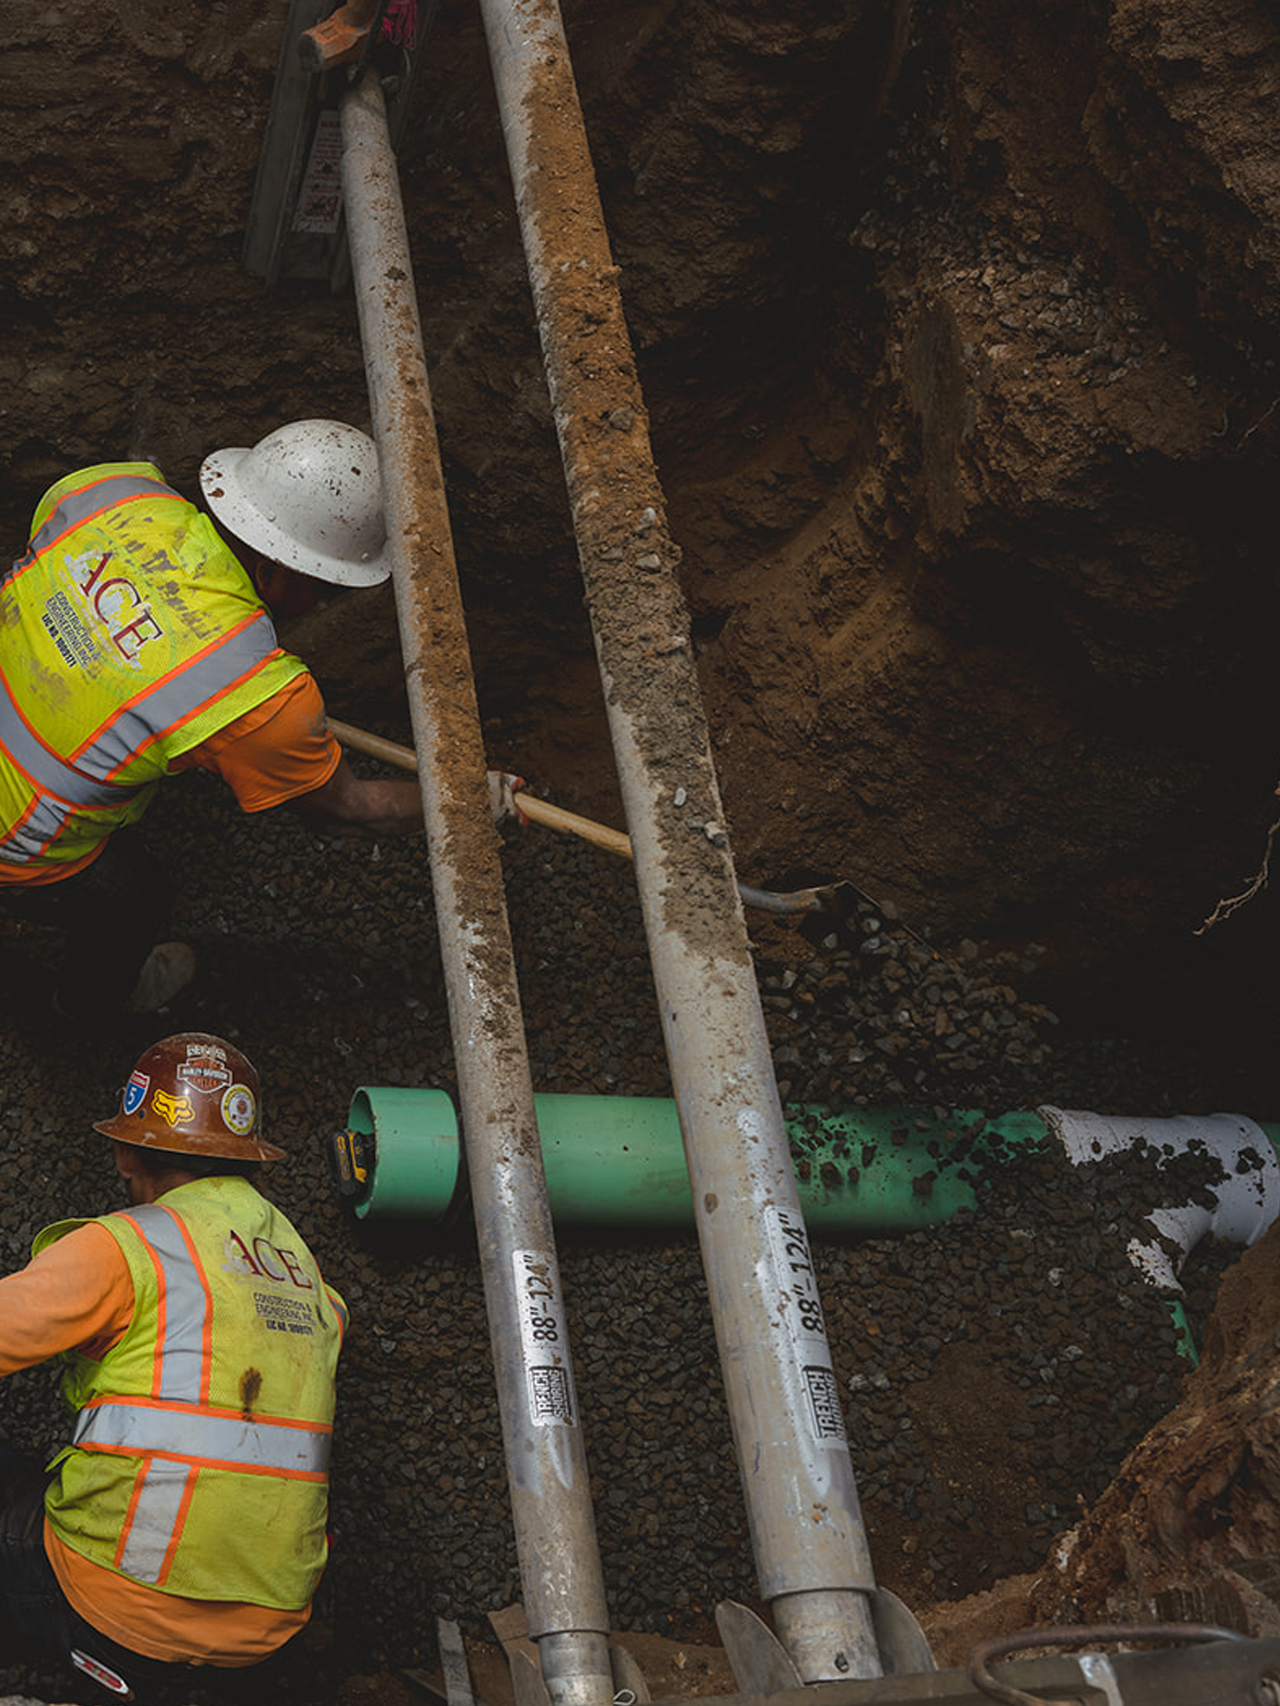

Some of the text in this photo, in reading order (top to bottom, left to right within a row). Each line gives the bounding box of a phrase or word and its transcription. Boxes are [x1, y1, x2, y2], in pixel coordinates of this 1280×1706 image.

[55, 591, 97, 652] CONSTRUCTION
[64, 549, 162, 660] ACE
[127, 1086, 137, 1106] 5
[224, 1229, 313, 1290] ACE
[778, 1212, 823, 1335] 88"-124"
[532, 1369, 554, 1418] TRENCH
[807, 1370, 837, 1439] TRENCH
